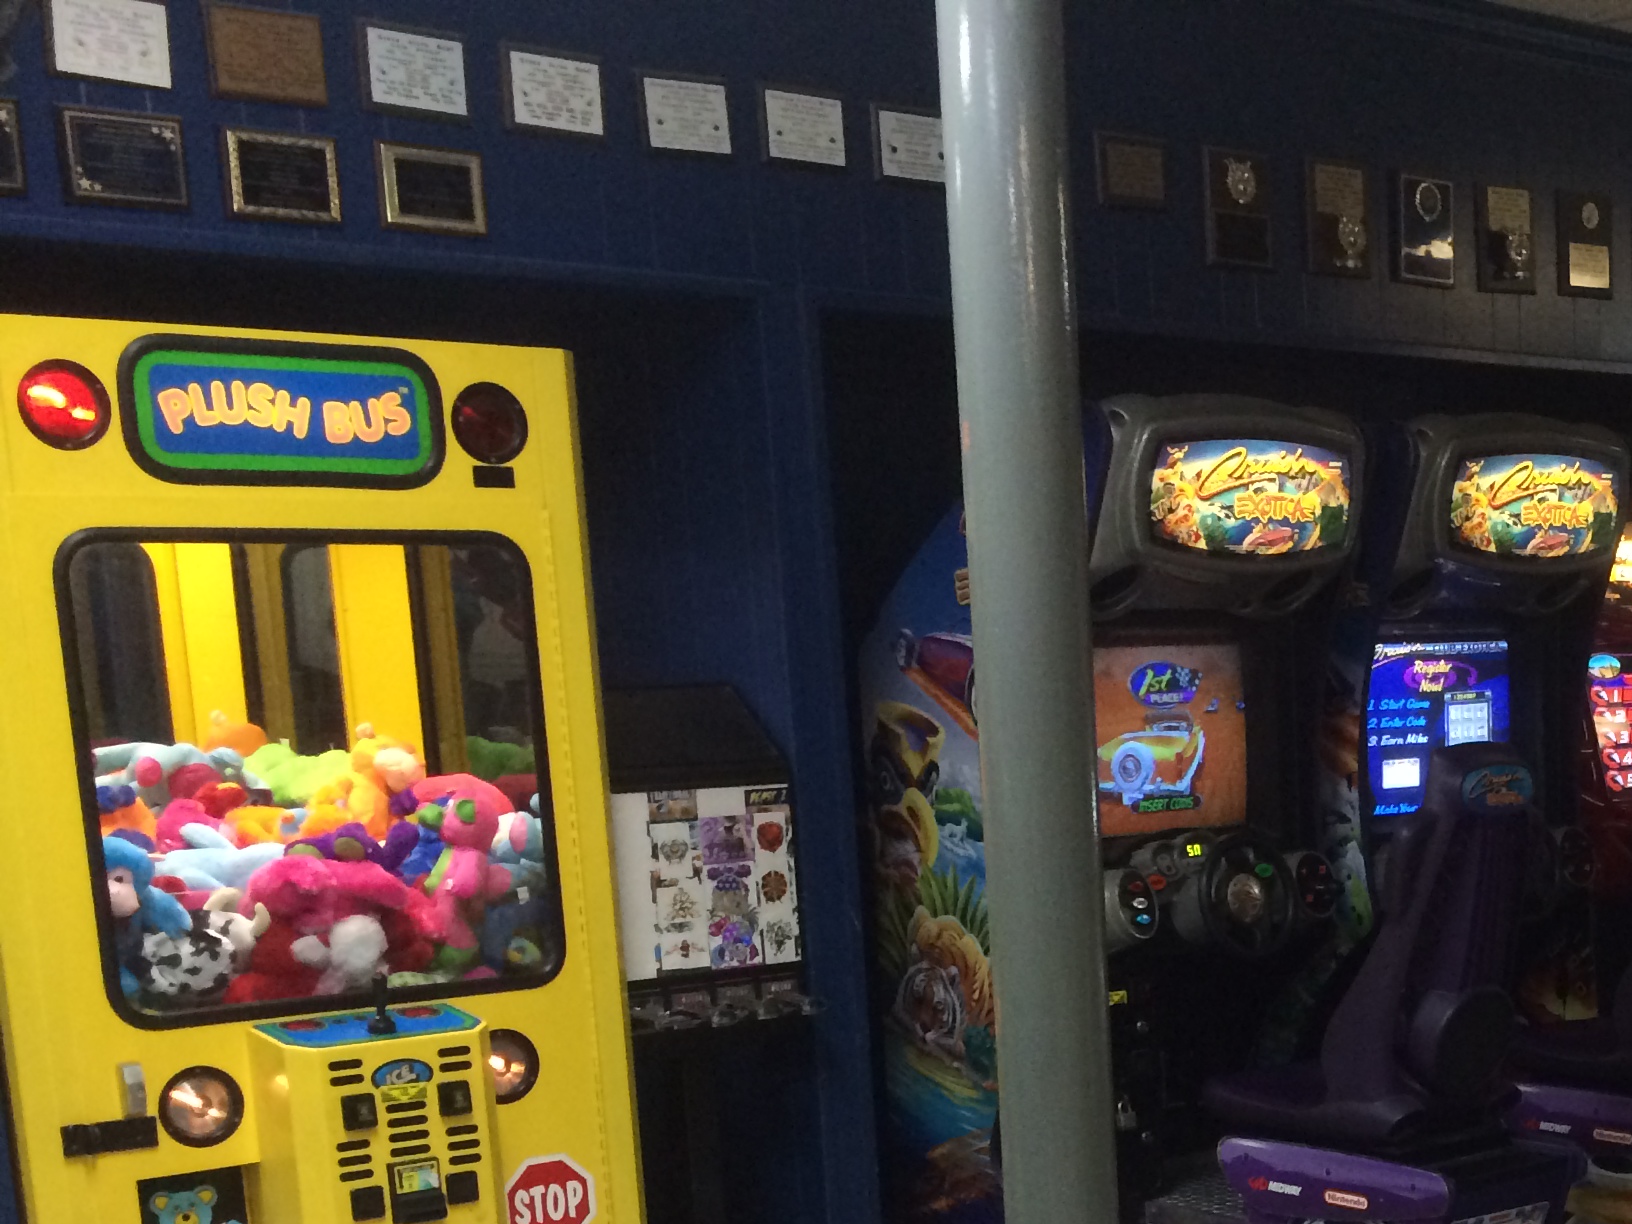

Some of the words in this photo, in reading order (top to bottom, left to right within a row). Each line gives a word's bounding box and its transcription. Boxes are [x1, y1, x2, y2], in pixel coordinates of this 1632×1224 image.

[157, 380, 311, 440] PLUSH
[322, 391, 411, 444] BUS
[1235, 492, 1315, 524] EXOTICA
[1520, 502, 1589, 529] EXOTICA
[1138, 668, 1173, 699] 1st
[1413, 659, 1453, 679] Register
[1326, 1192, 1367, 1209] Nintendo
